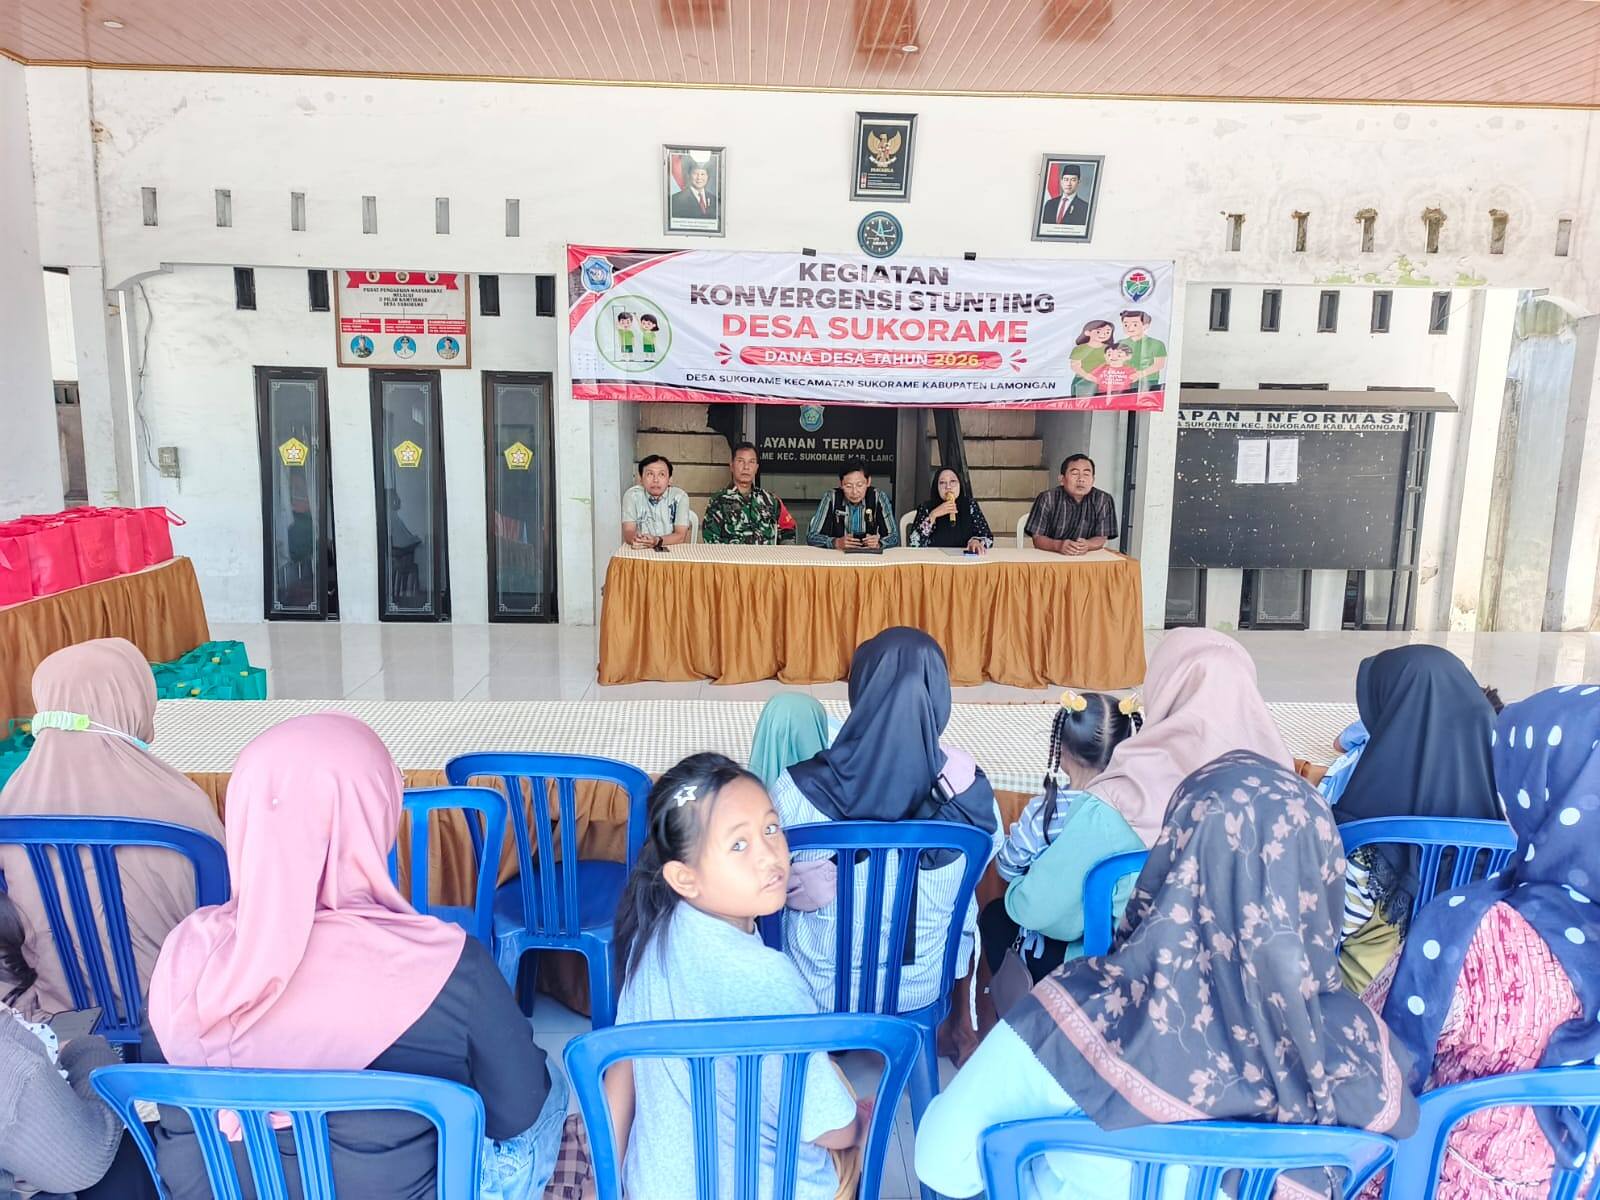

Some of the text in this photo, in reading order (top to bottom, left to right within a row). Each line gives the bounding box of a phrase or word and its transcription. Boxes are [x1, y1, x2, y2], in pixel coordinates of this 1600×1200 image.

[799, 262, 949, 285] KEGIATAN
[690, 284, 1055, 313] KONVERGENSI STUNTING
[722, 313, 1028, 343] DESA SUKORAME
[764, 351, 979, 366] DANA DESA TAHUN 2026
[686, 373, 1056, 390] DESA SUKORAME KECAMATAN SUKORAME KABUPATEN LAMONGAN
[1256, 412, 1404, 424] INFORMASI
[760, 437, 884, 450] AYANAN TERPADU
[777, 452, 798, 461] KEC.
[800, 453, 845, 461] SUKORAME
